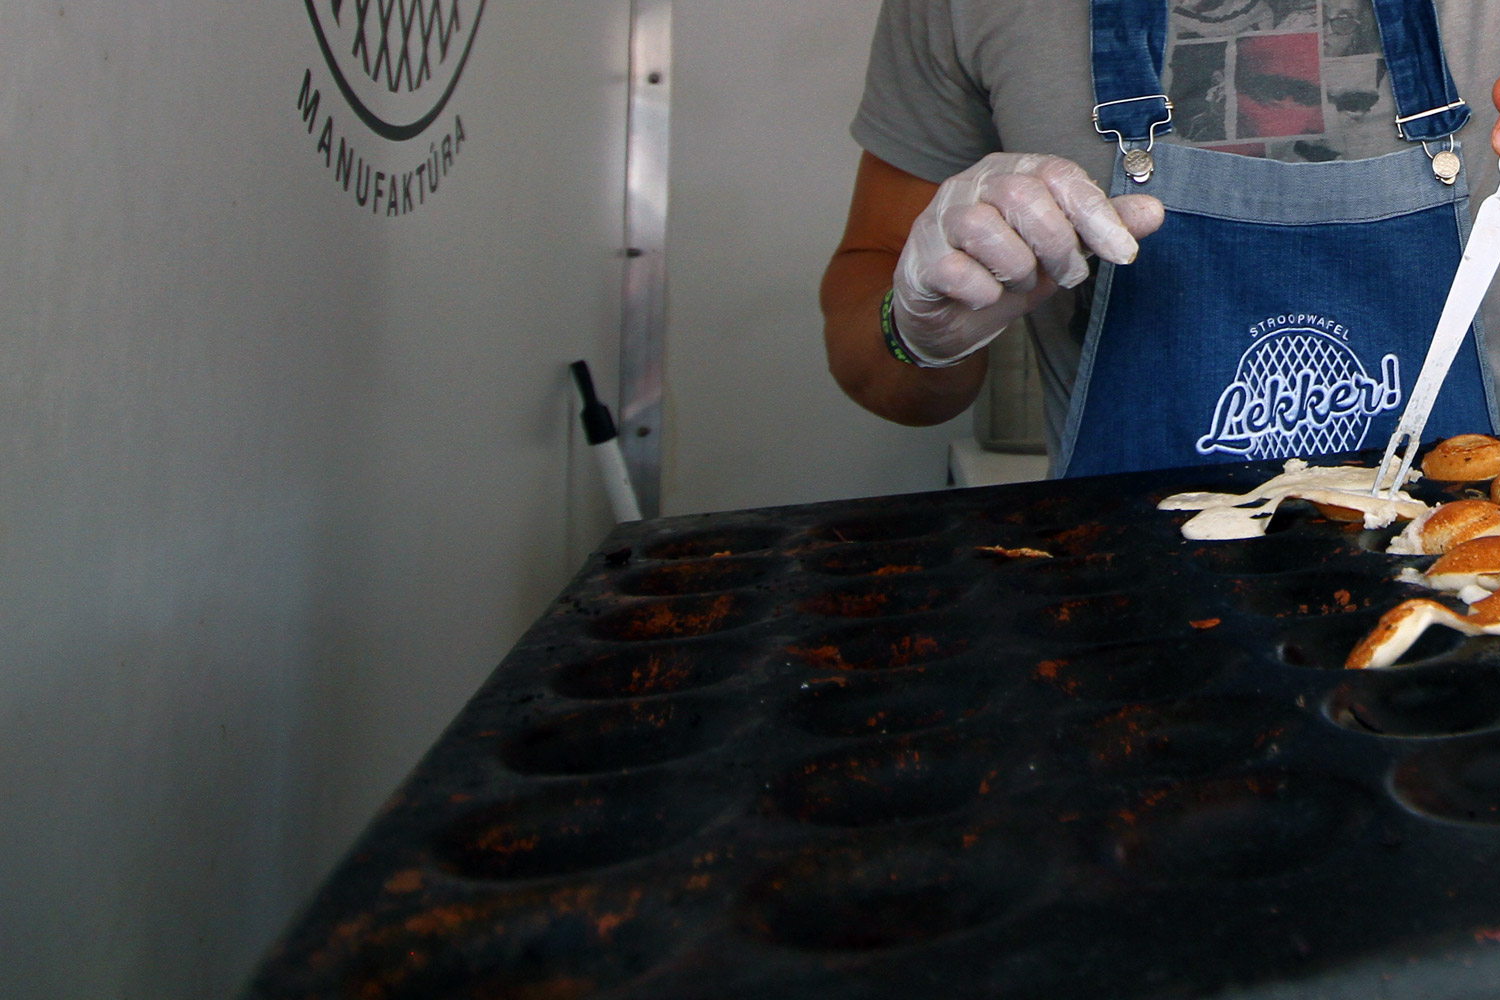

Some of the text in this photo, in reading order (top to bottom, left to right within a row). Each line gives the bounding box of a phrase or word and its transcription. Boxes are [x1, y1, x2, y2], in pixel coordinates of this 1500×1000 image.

[298, 68, 466, 217] MANUFAKTÚRA
[1249, 314, 1350, 341] STROOPWAFEL
[1195, 353, 1402, 455] Lekker!
